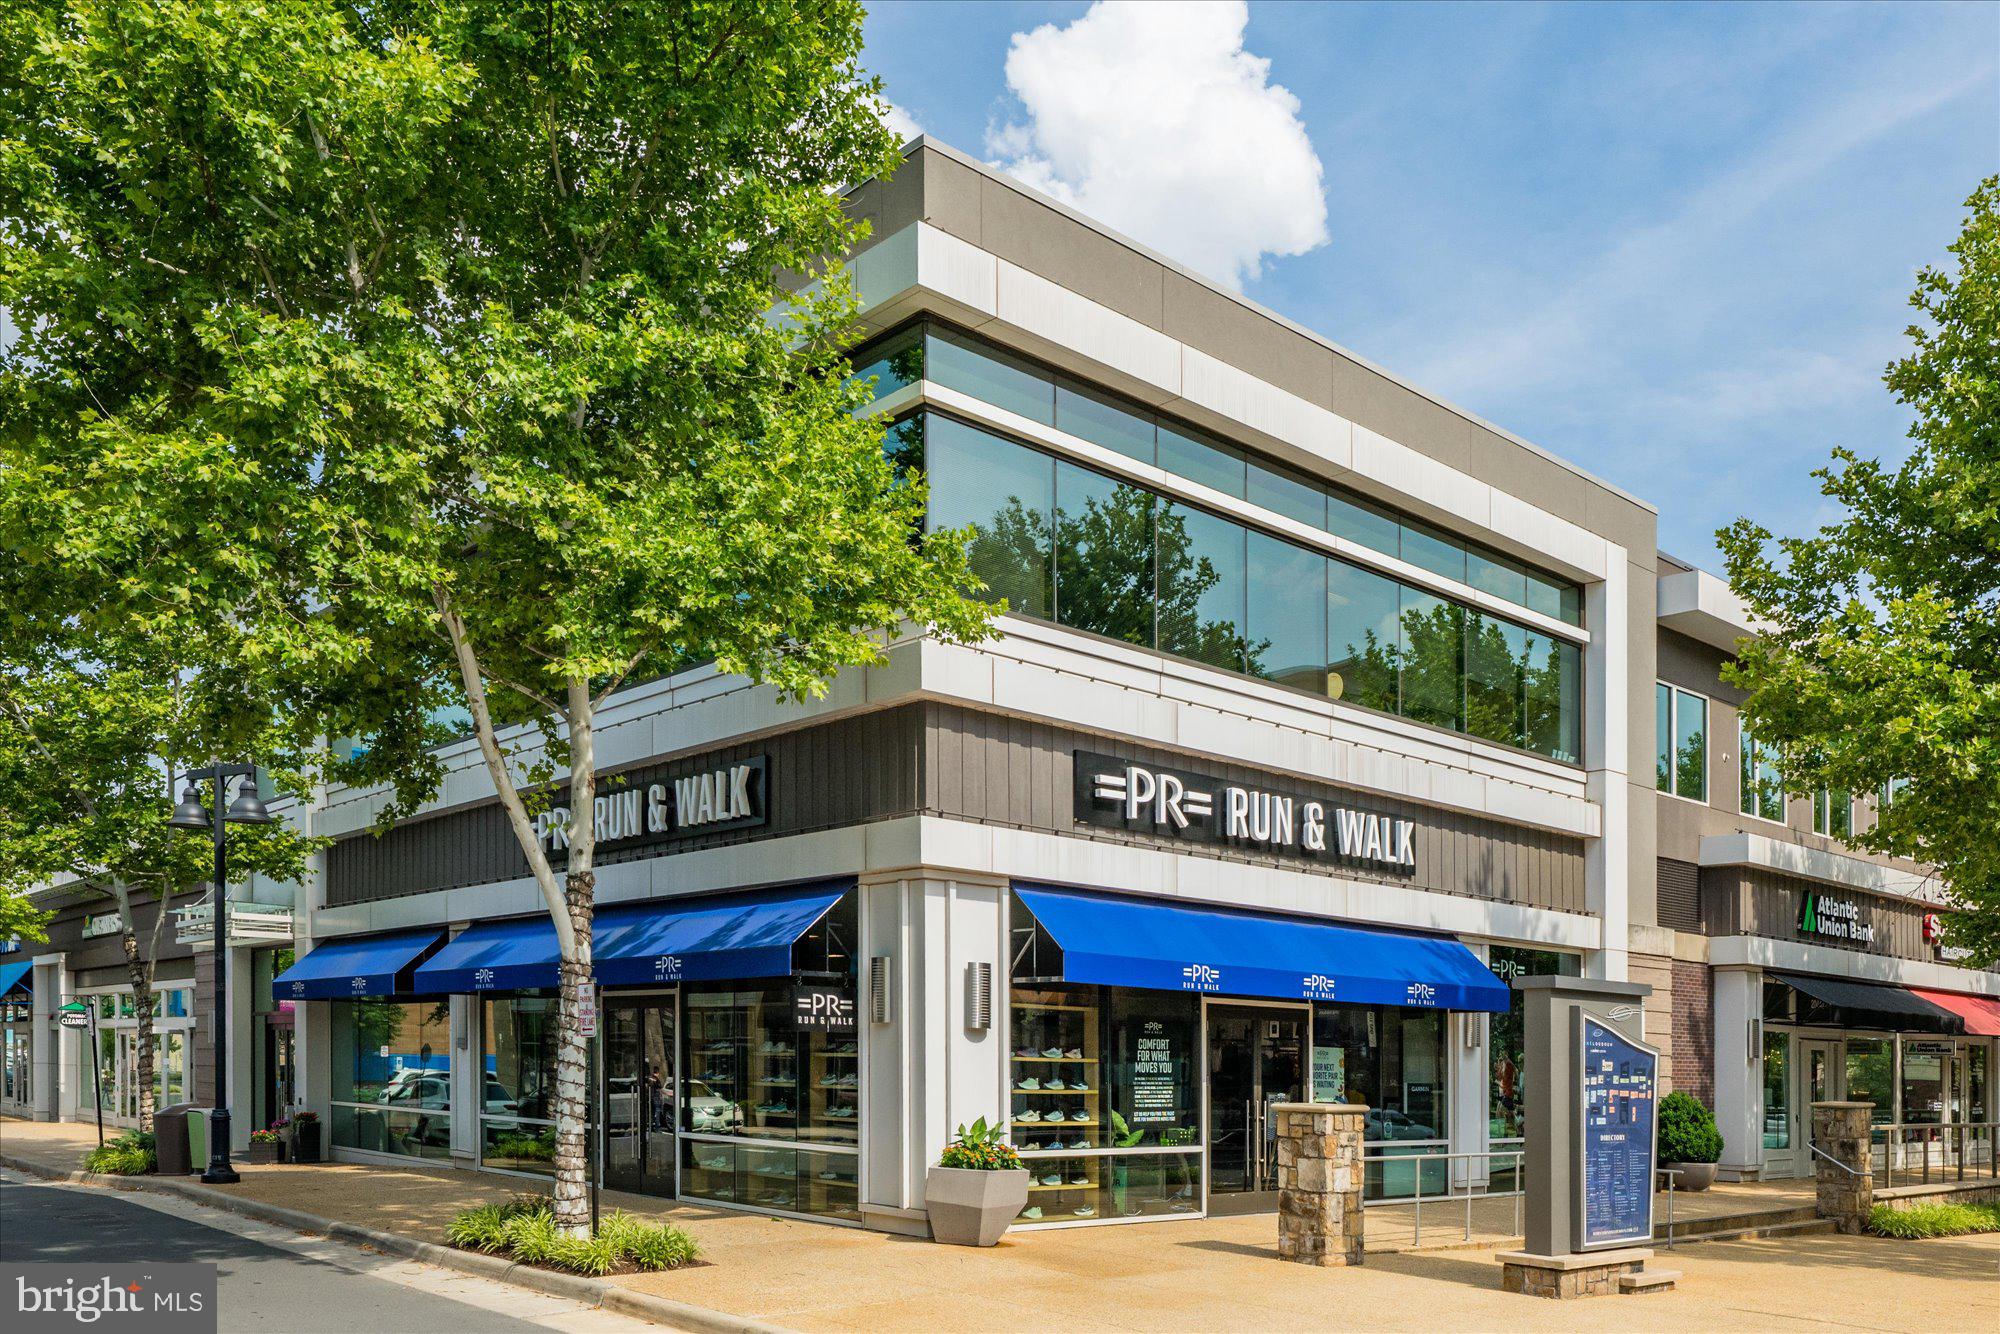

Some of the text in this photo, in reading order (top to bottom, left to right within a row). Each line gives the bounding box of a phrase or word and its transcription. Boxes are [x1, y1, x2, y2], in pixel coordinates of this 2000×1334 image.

[594, 789, 643, 842] RUN
[648, 784, 668, 832] &
[675, 765, 751, 827] WALK
[1226, 787, 1292, 845] RUN
[1303, 802, 1326, 850] &
[1336, 808, 1414, 866] WALK
[1818, 895, 1859, 920] Atlantic
[1817, 914, 1875, 942] Union Bank
[1183, 981, 1195, 989] RUN
[1204, 983, 1220, 991] WALK
[798, 1016, 853, 1026] RUN & WALK
[1138, 1038, 1170, 1050] COMFORT
[1137, 1050, 1170, 1061] FOR WHAT
[1135, 1062, 1173, 1073] MOVES YOU
[1328, 1071, 1339, 1080] PAIR
